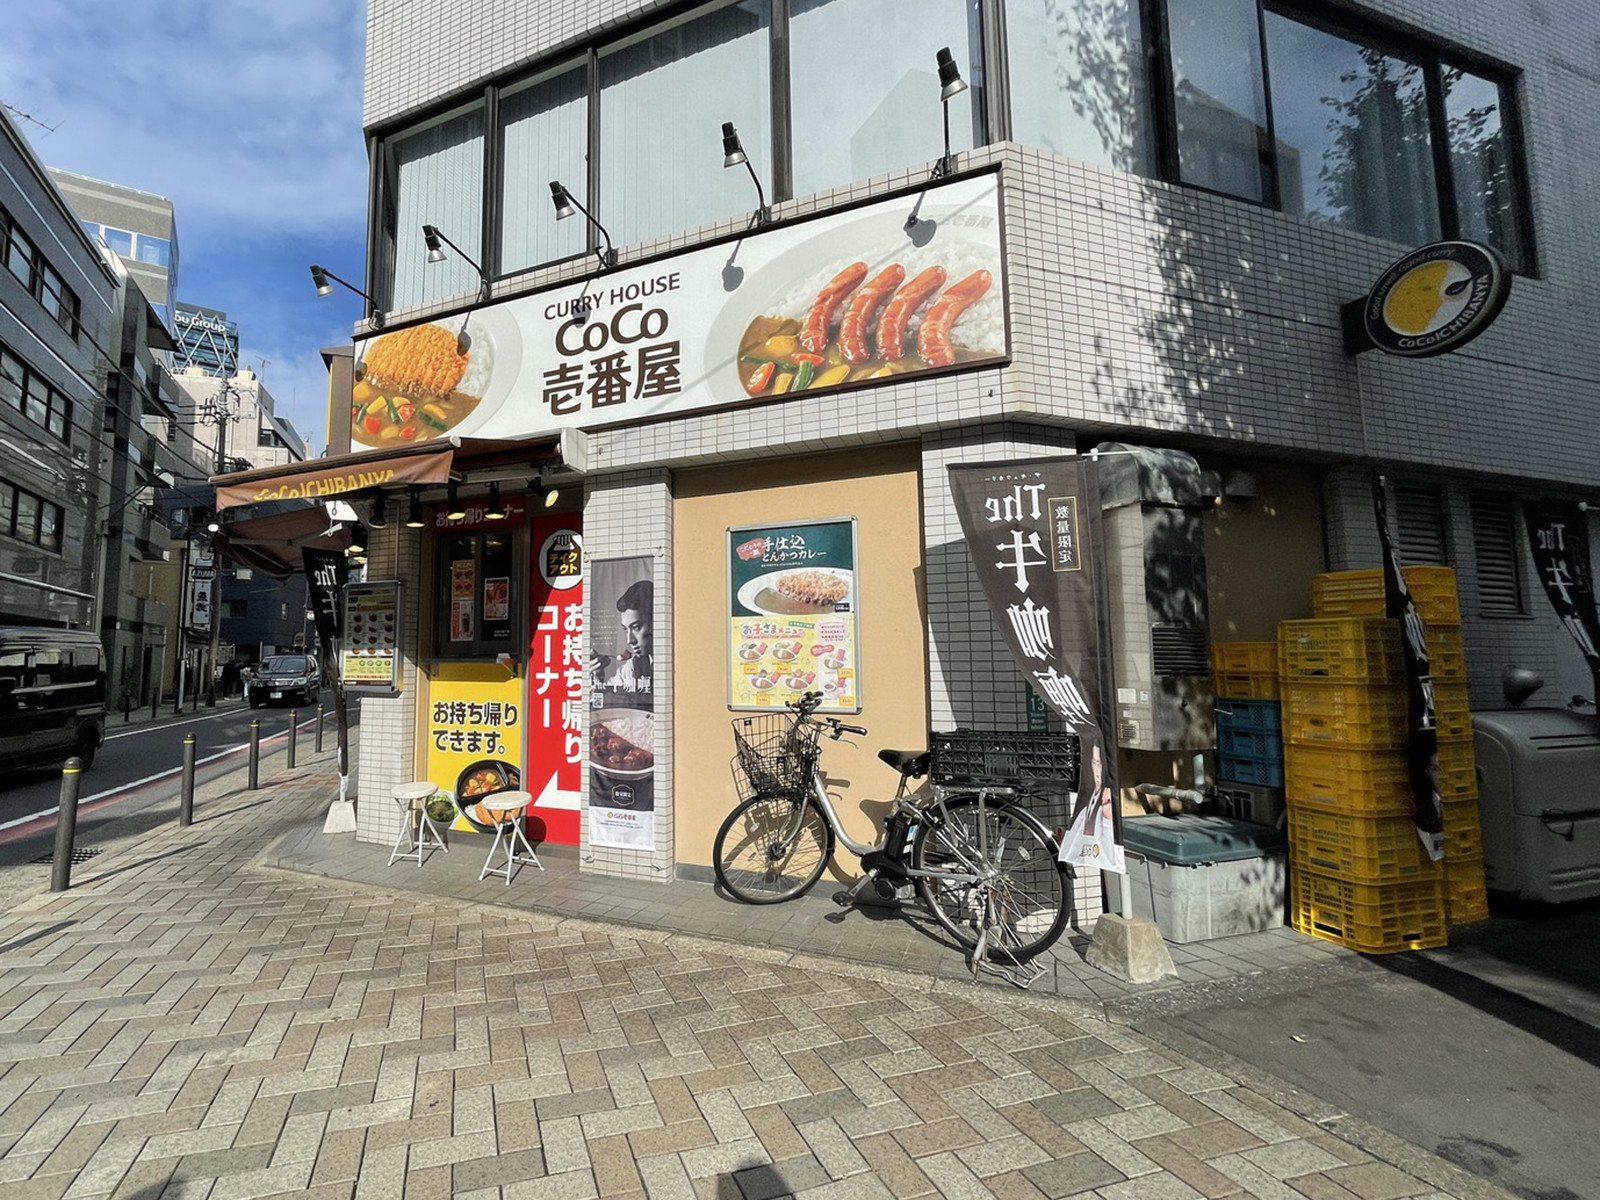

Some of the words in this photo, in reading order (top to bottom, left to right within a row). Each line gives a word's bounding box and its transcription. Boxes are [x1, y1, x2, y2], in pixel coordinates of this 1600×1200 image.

[544, 290, 605, 321] CURRY
[609, 271, 681, 306] HOUSE
[191, 316, 226, 333] Group
[555, 302, 670, 357] CoCo
[542, 340, 682, 416] 壱番屋
[761, 534, 806, 552] 手仕込
[762, 549, 827, 562] とんかつカレー
[550, 552, 578, 564] テイク
[550, 563, 578, 575] アウト
[534, 605, 559, 728] コーナー
[562, 603, 583, 764] お持ち帰り
[433, 701, 518, 727] お持ち帰り
[432, 729, 506, 755] できます。
